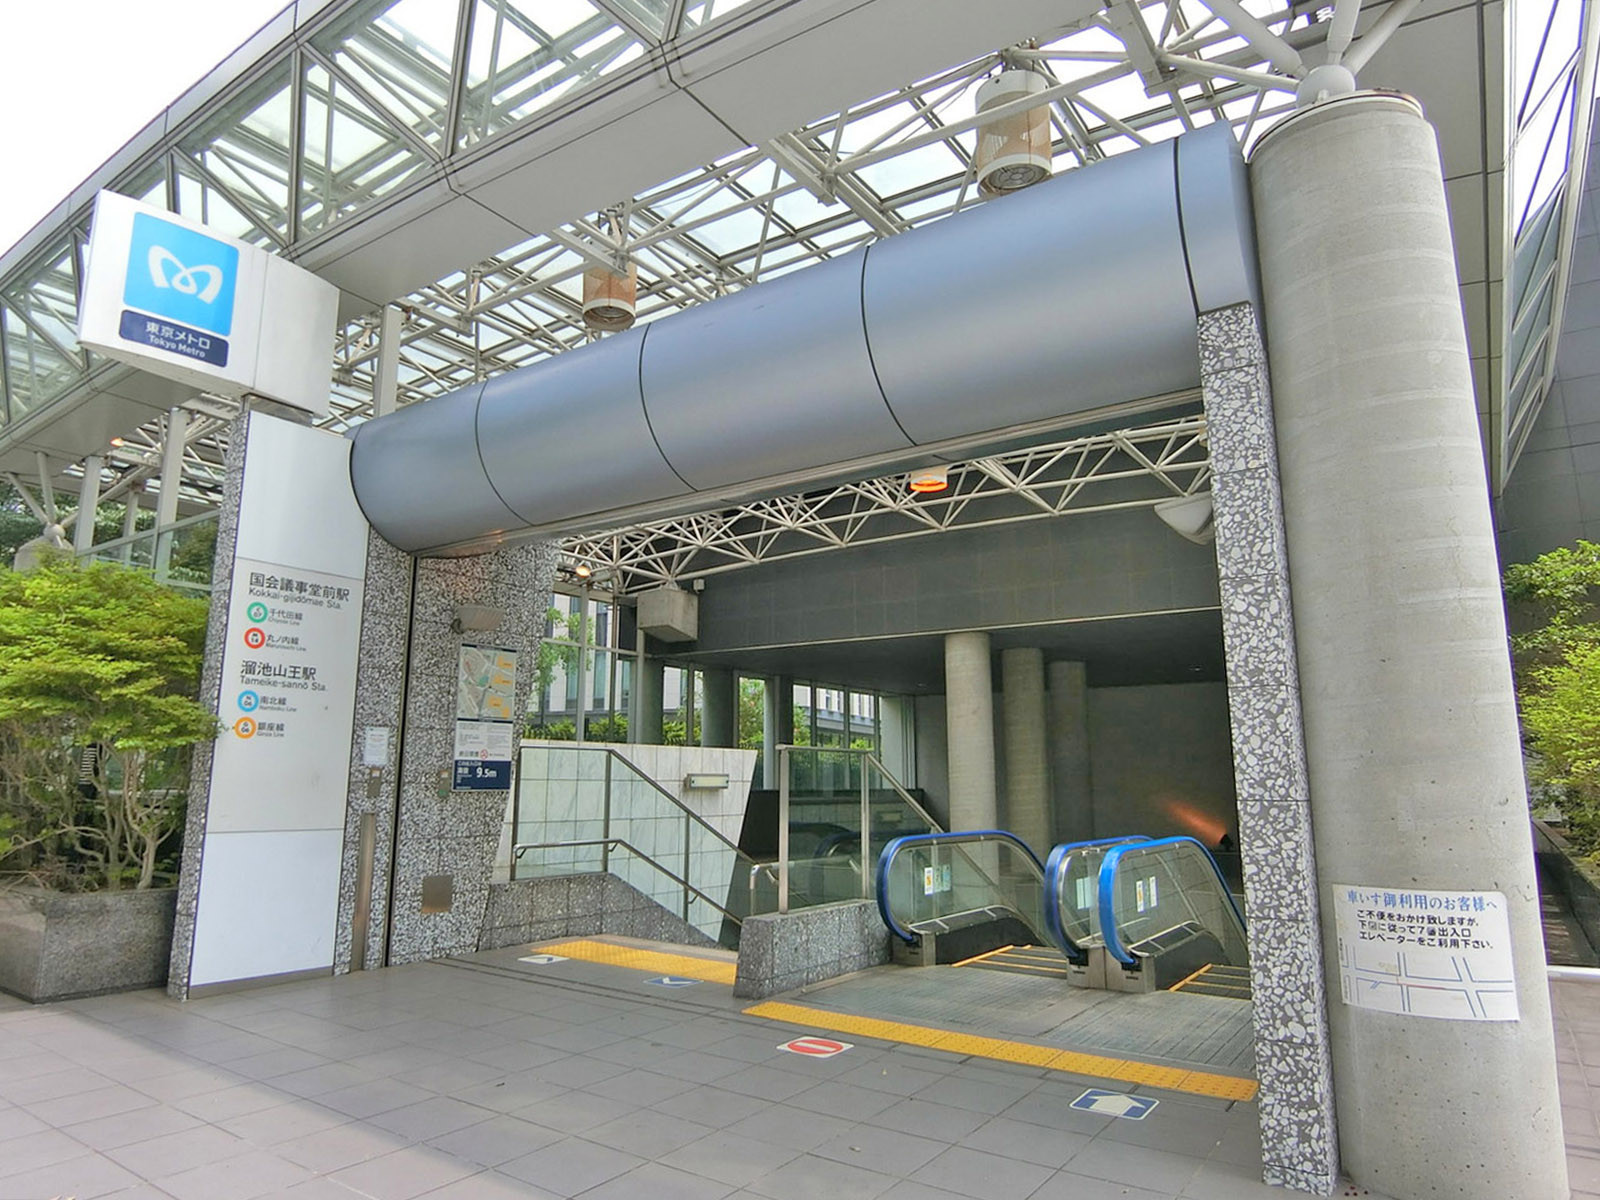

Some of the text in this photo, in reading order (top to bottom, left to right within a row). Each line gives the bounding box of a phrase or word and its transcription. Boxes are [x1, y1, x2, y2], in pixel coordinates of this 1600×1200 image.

[146, 321, 211, 350] 東京メトロ
[149, 335, 206, 358] Tokyo Metro
[249, 572, 350, 602] 国会議事堂前駅
[269, 608, 303, 621] 千代田線
[267, 634, 299, 645] 丸ノ内線
[240, 660, 317, 681] 溜池山王駅
[260, 696, 287, 706] 南北線
[258, 722, 285, 732] 銀座線
[476, 767, 497, 778] 9.5m
